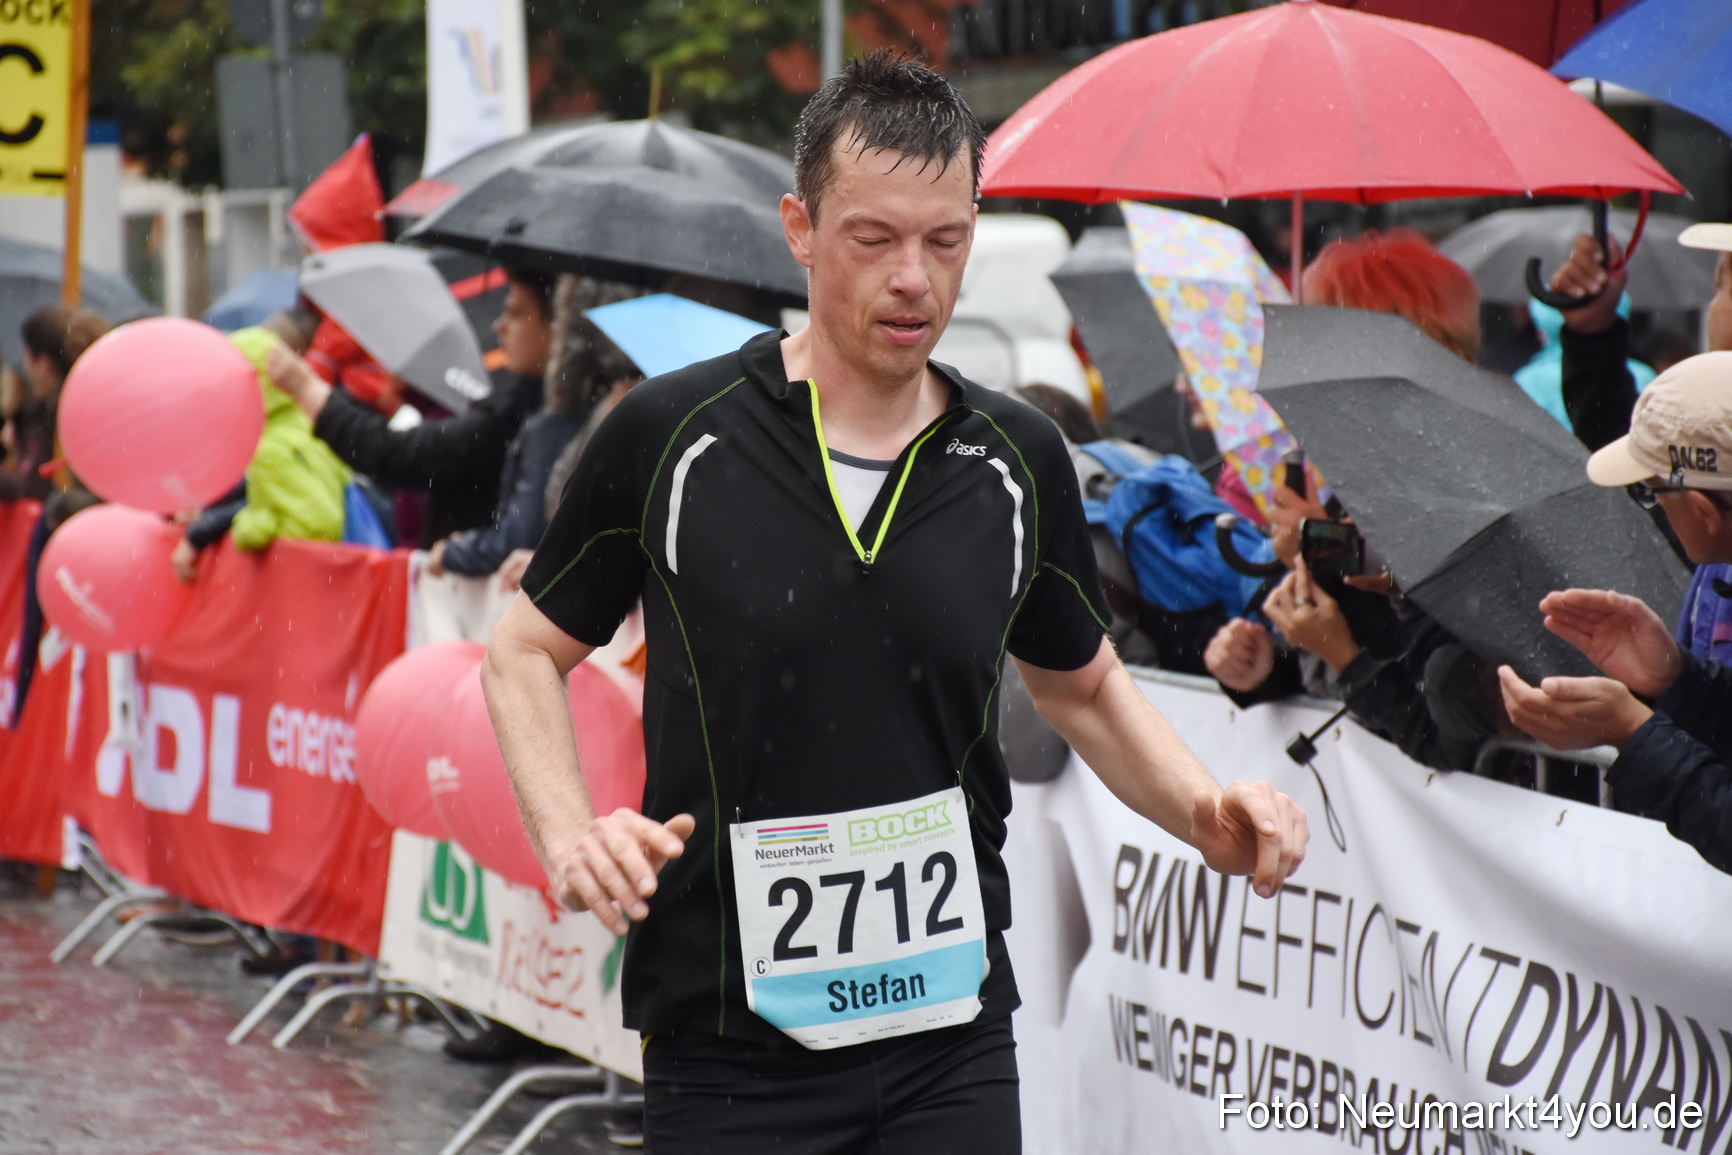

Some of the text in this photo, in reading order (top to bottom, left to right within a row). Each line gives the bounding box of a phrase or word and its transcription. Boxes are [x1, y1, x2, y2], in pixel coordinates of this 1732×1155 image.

[955, 442, 988, 457] asics
[848, 799, 953, 847] BOCK
[755, 842, 835, 861] NeuerMarkt
[850, 827, 956, 857] inspired by smart concepts
[768, 851, 964, 962] 2712
[1113, 843, 1231, 982] BMW
[755, 959, 767, 975] C
[827, 973, 926, 1014] Stefan
